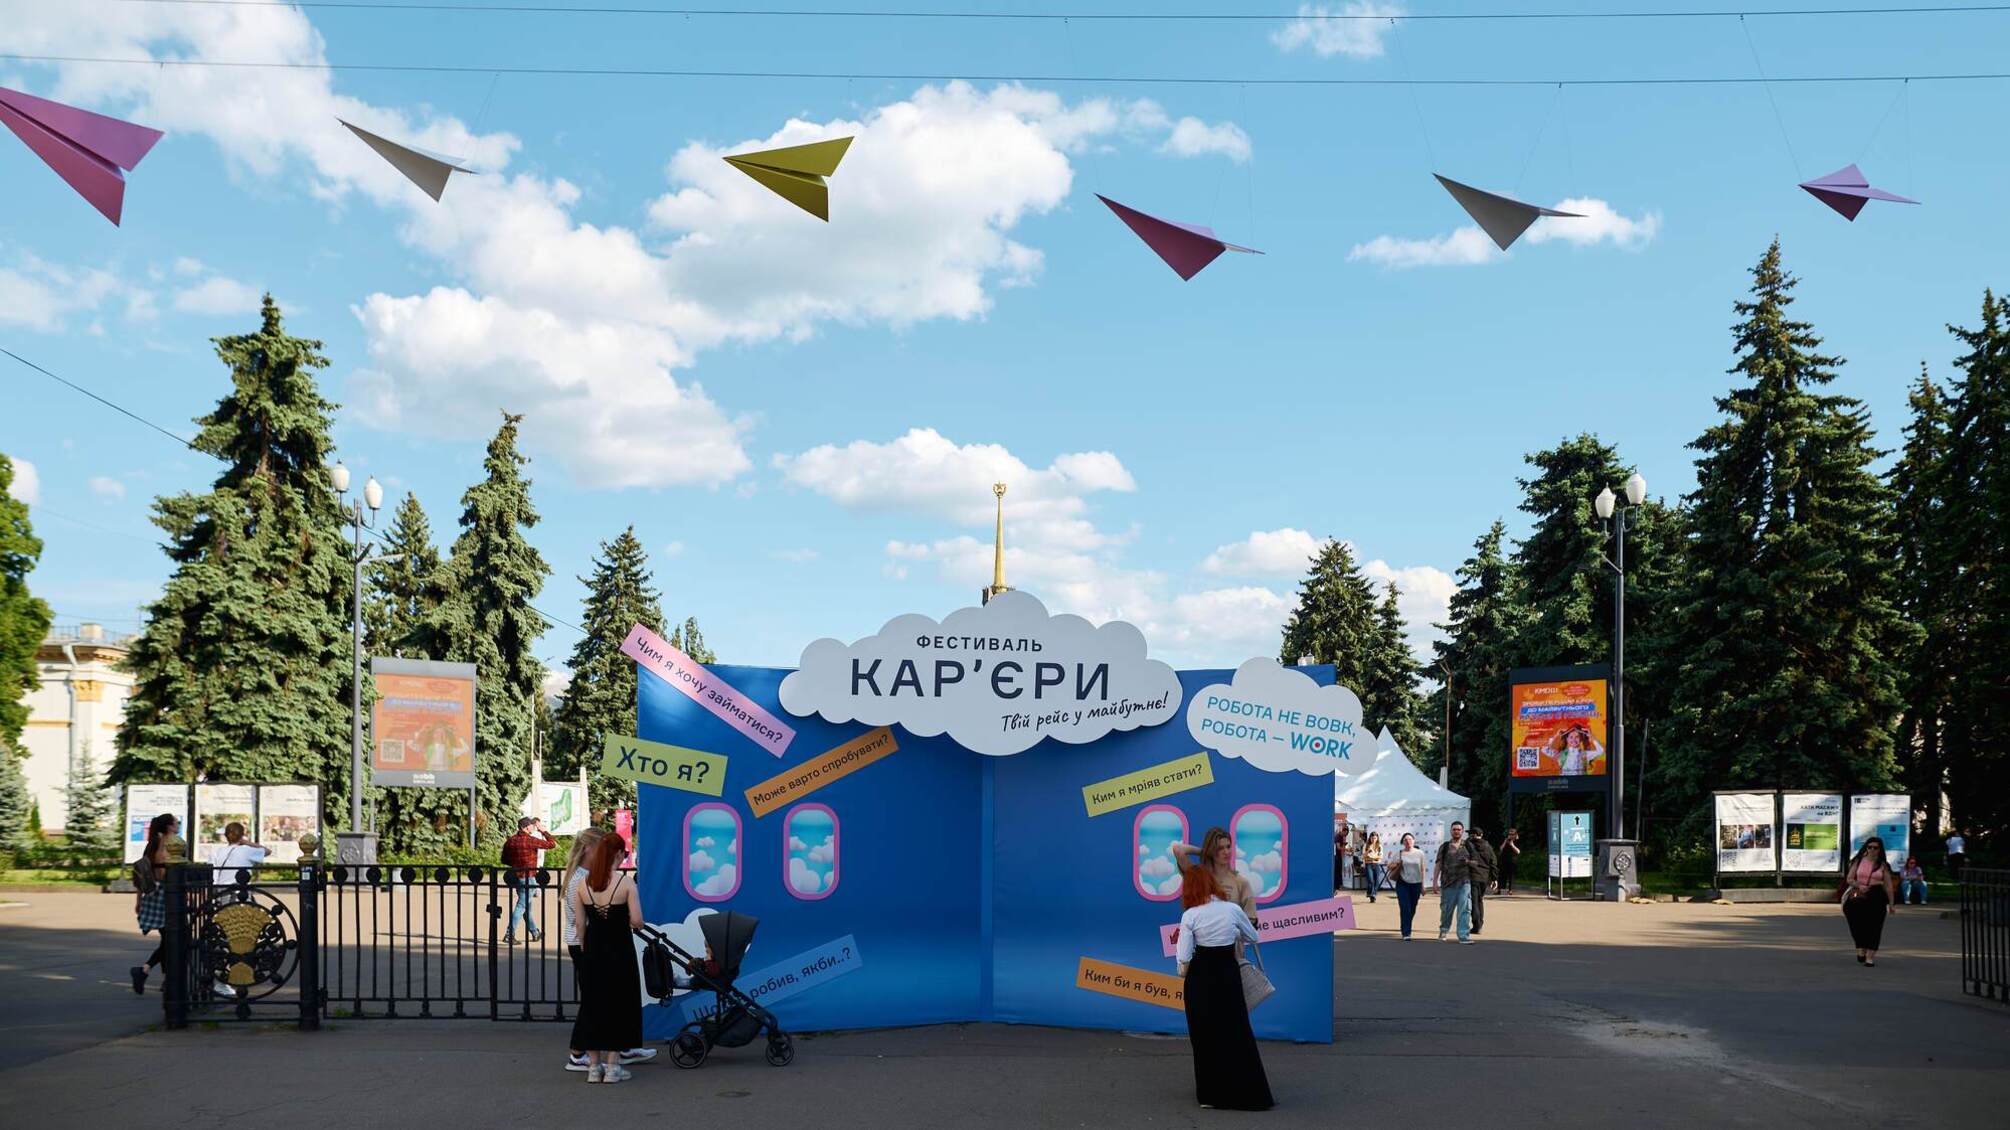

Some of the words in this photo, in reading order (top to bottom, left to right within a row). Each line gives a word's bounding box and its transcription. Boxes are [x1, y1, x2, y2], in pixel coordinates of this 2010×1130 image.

[916, 635, 1043, 652] ФЕСТИВАЛЬ
[634, 635, 664, 664] Чим
[664, 659, 675, 671] я
[675, 666, 707, 695] хочу
[707, 683, 784, 745] займатися?
[1000, 712, 1033, 732] Твій
[1036, 710, 1070, 731] рейс
[1073, 711, 1085, 727] у
[1086, 691, 1170, 722] майбутнє!
[1207, 695, 1274, 721] РОБОТА
[1278, 709, 1301, 726] НЕ
[1305, 713, 1357, 737] ВОВК,
[1201, 718, 1267, 743] РОБОТА
[1289, 730, 1354, 760] WORK
[616, 745, 669, 778] Хто
[676, 761, 710, 784] я?
[753, 784, 788, 807] Може
[788, 766, 822, 791] варто
[822, 733, 890, 776] спробувати?
[1091, 788, 1117, 806] Ким
[1118, 786, 1126, 797] я
[1128, 775, 1162, 795] мріяв
[1163, 763, 1204, 786] стати?
[1271, 906, 1346, 931] щасливим?
[749, 971, 800, 1002] робив,
[801, 946, 852, 978] якби..?
[1084, 968, 1111, 985] Ким
[1113, 974, 1130, 989] би
[1132, 981, 1141, 992] я
[1144, 981, 1172, 1000] був,
